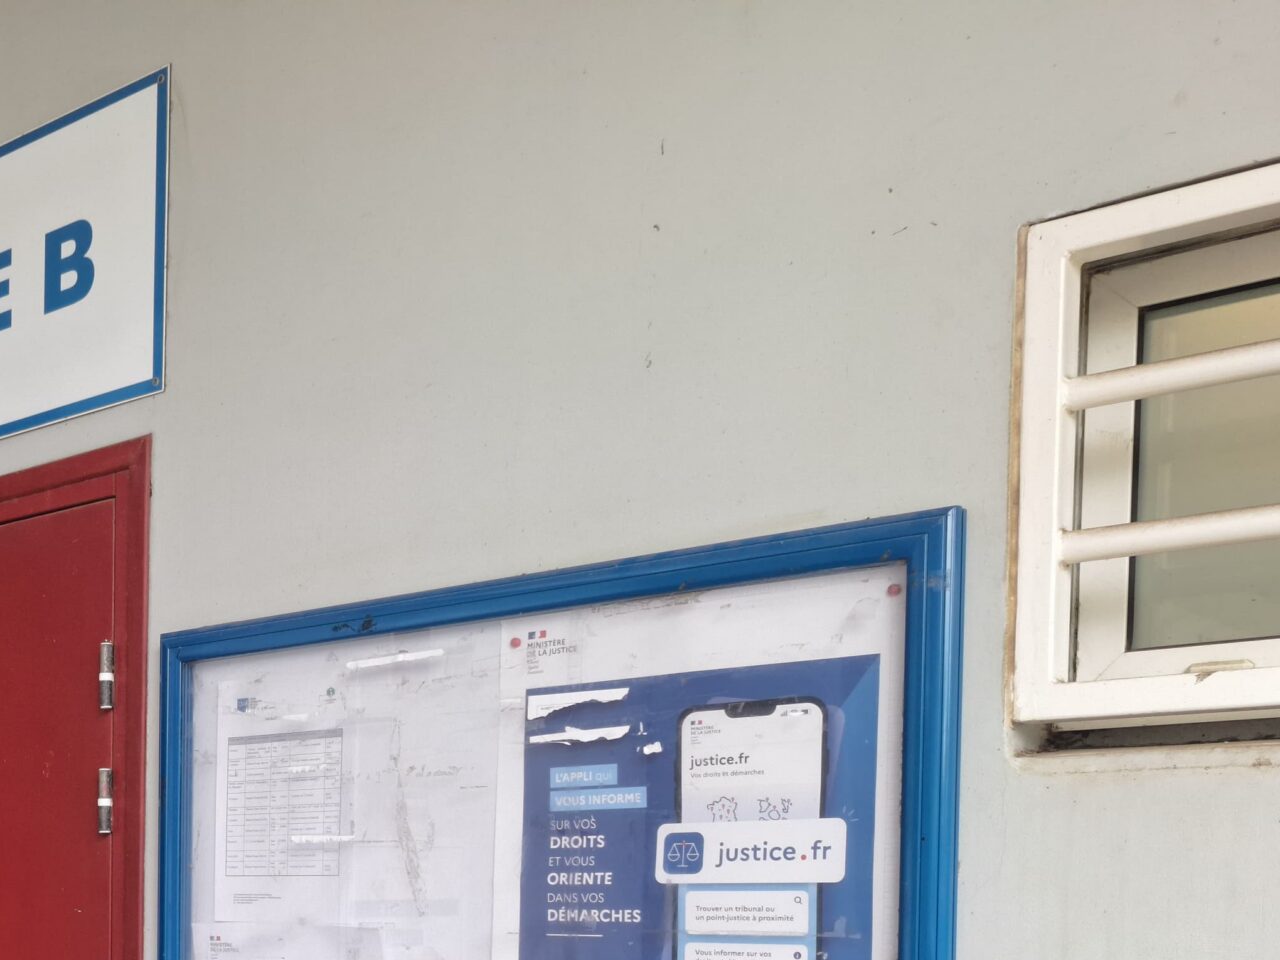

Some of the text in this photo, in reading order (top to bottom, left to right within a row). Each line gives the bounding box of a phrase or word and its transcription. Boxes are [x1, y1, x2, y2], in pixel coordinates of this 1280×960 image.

[44, 219, 96, 314] B
[549, 646, 577, 656] JUSTICE
[689, 753, 750, 770] justice.fr
[555, 770, 592, 784] L'APPLI
[731, 769, 764, 777] démarches
[555, 792, 642, 806] VOUS INFORME
[550, 819, 597, 830] SUR VOS
[550, 835, 605, 849] DROITS
[715, 839, 831, 868] justice.fr
[549, 856, 595, 867] ET VOUS
[547, 872, 612, 885] ORIENTE
[547, 893, 604, 903] DANS VOS
[547, 906, 641, 923] DÉMARCHES
[713, 949, 744, 957] informer
